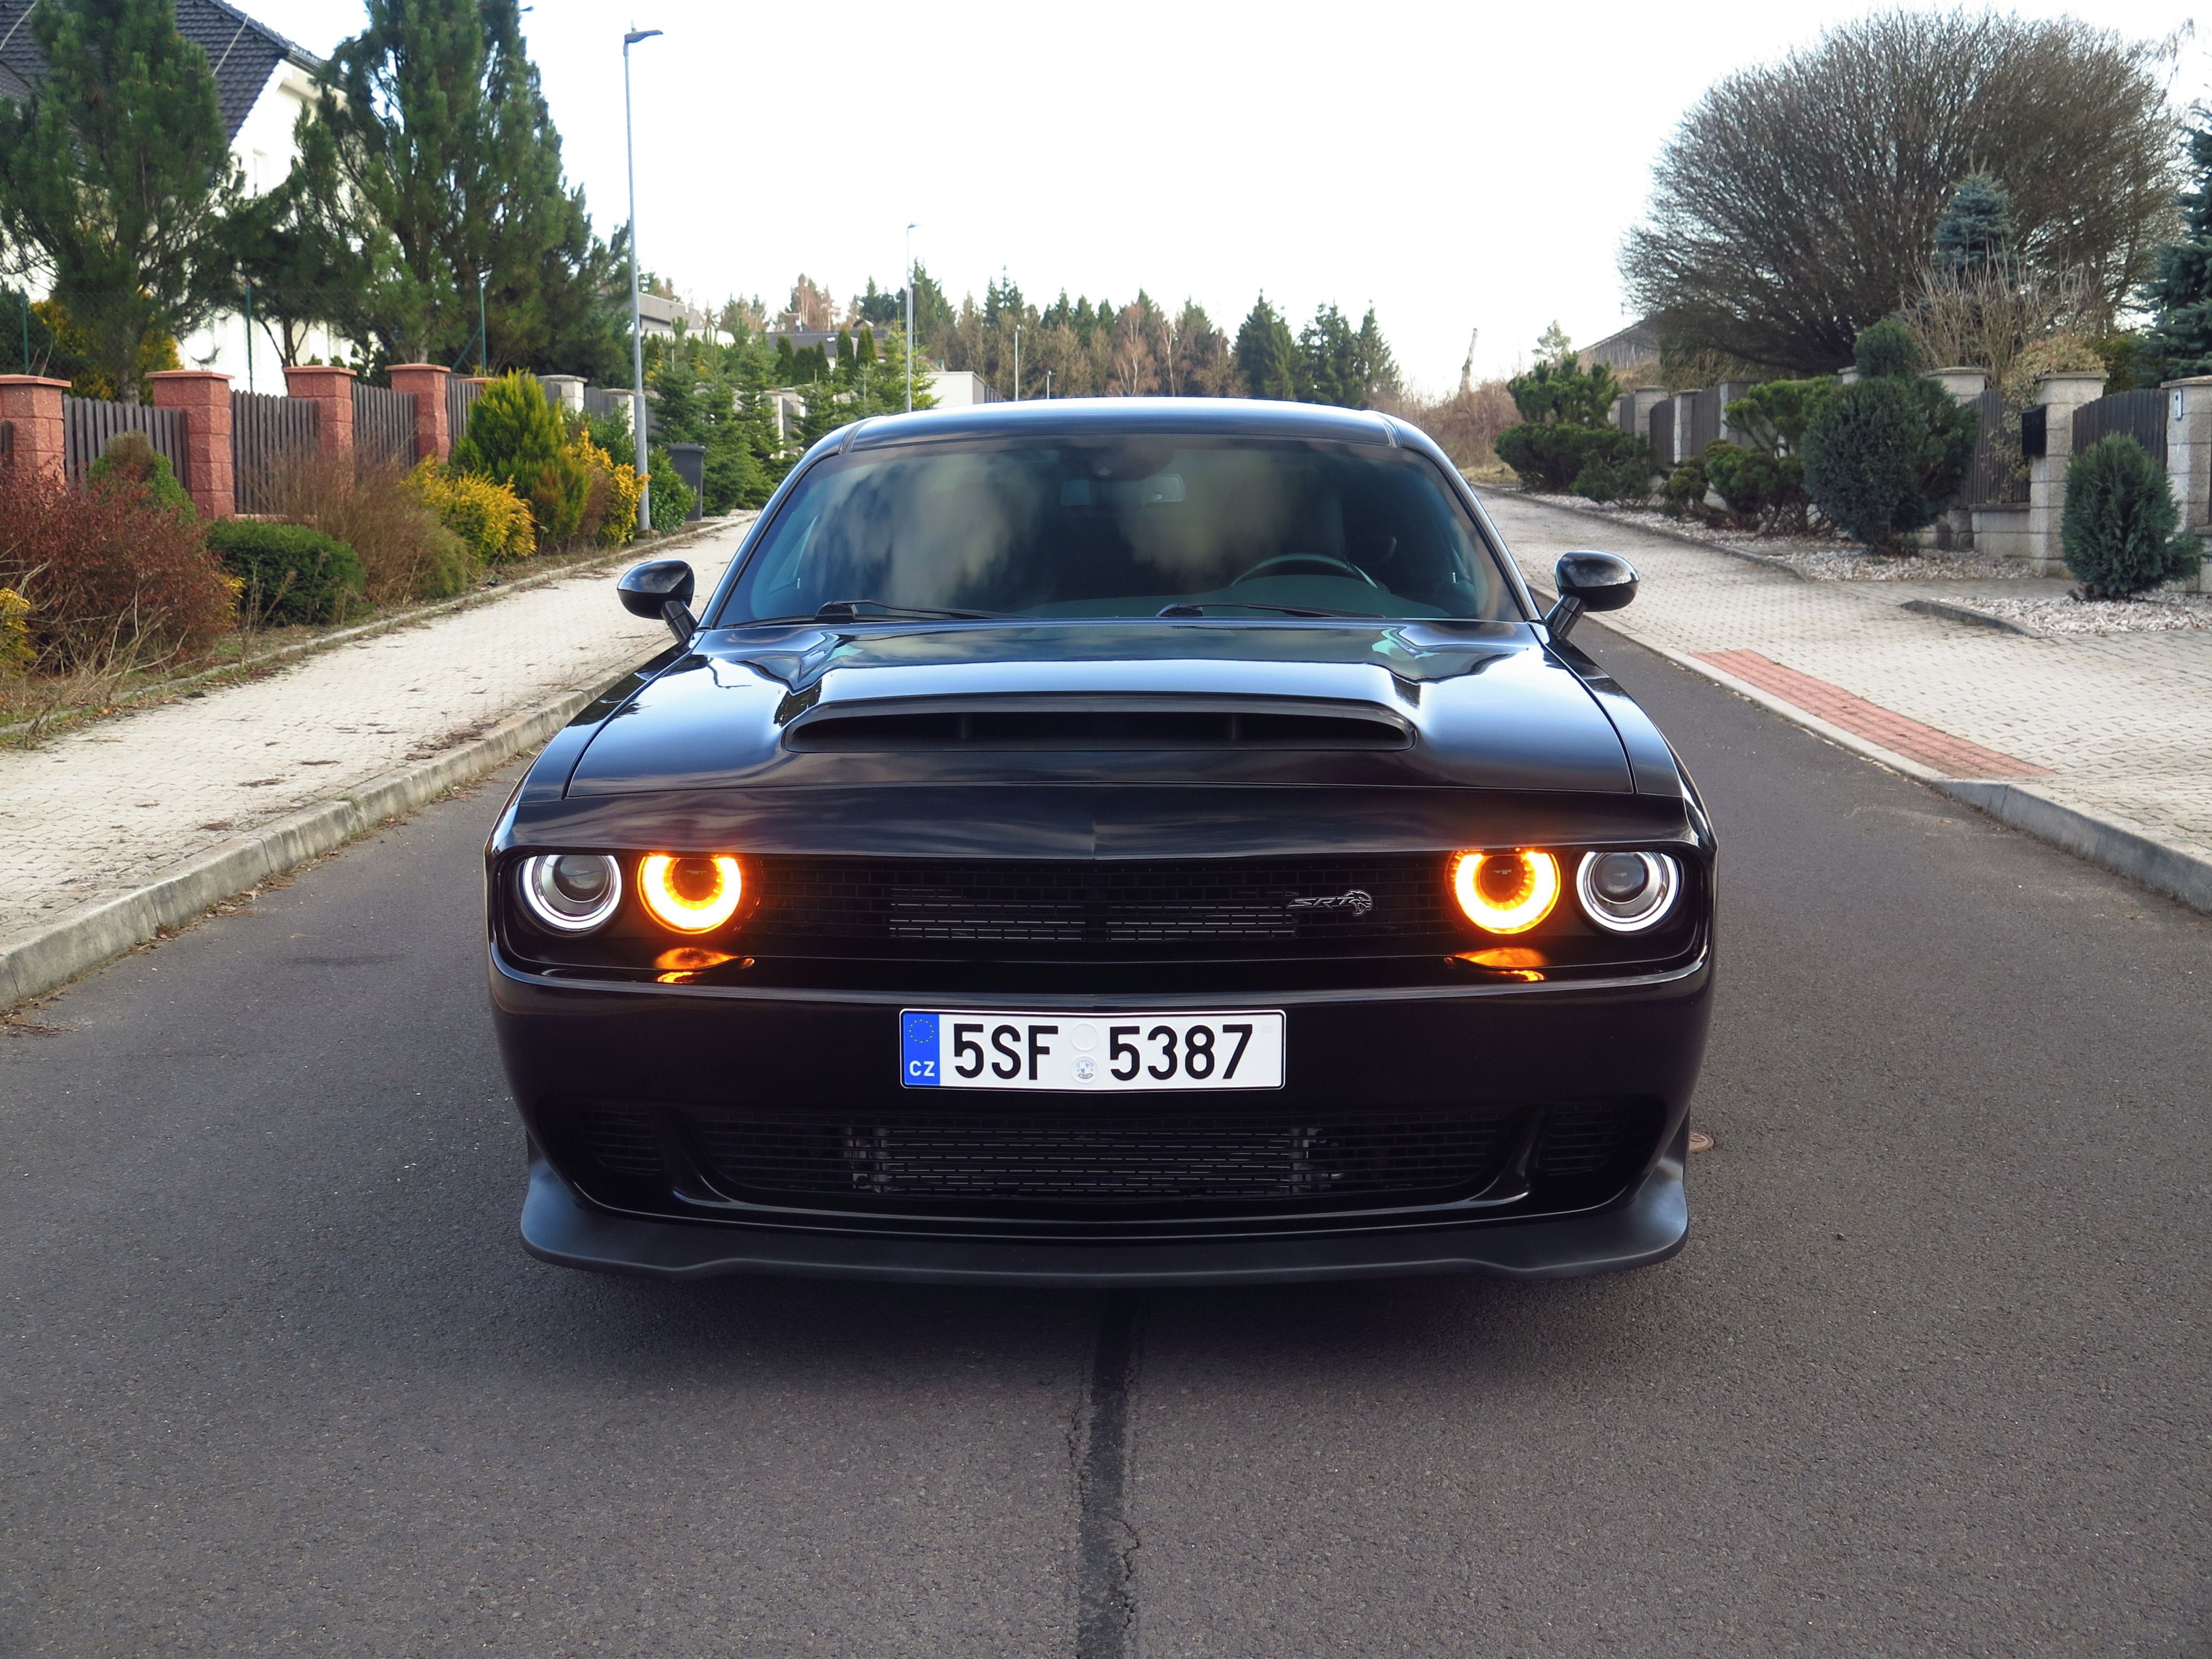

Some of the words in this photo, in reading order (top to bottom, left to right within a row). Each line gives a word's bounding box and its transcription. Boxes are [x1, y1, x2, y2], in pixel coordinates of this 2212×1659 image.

[1286, 895, 1355, 909] SRT
[953, 1023, 1058, 1080] 5SF
[1109, 1024, 1253, 1081] 5387
[909, 1060, 935, 1077] CZ
